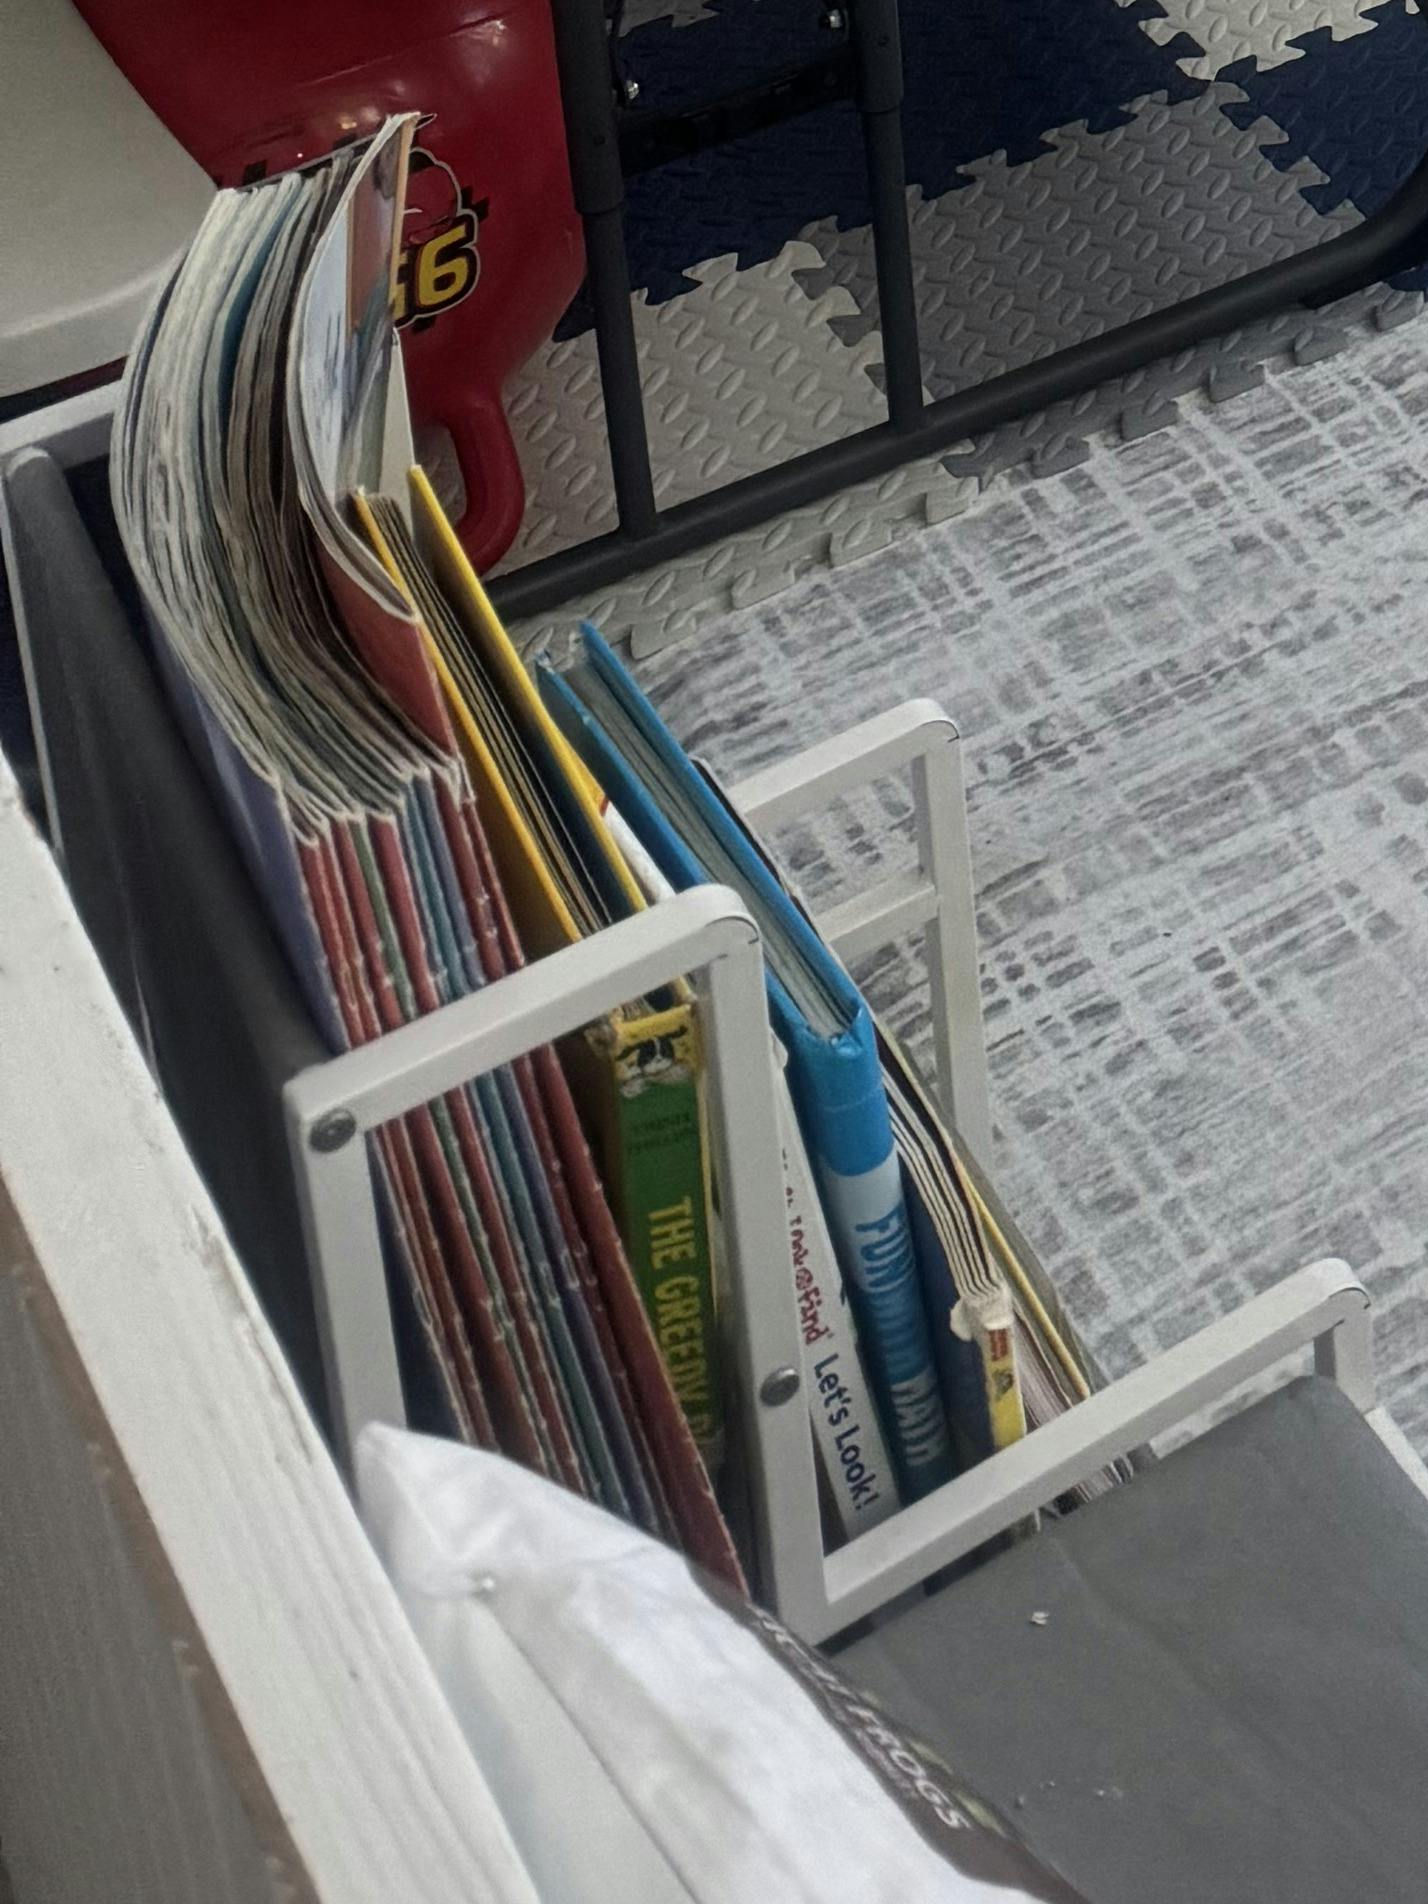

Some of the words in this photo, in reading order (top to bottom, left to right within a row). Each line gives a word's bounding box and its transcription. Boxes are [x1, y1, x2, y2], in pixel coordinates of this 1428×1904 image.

[649, 1197, 696, 1269] THE
[813, 1352, 850, 1427] Let's
[834, 1425, 880, 1511] Look!
